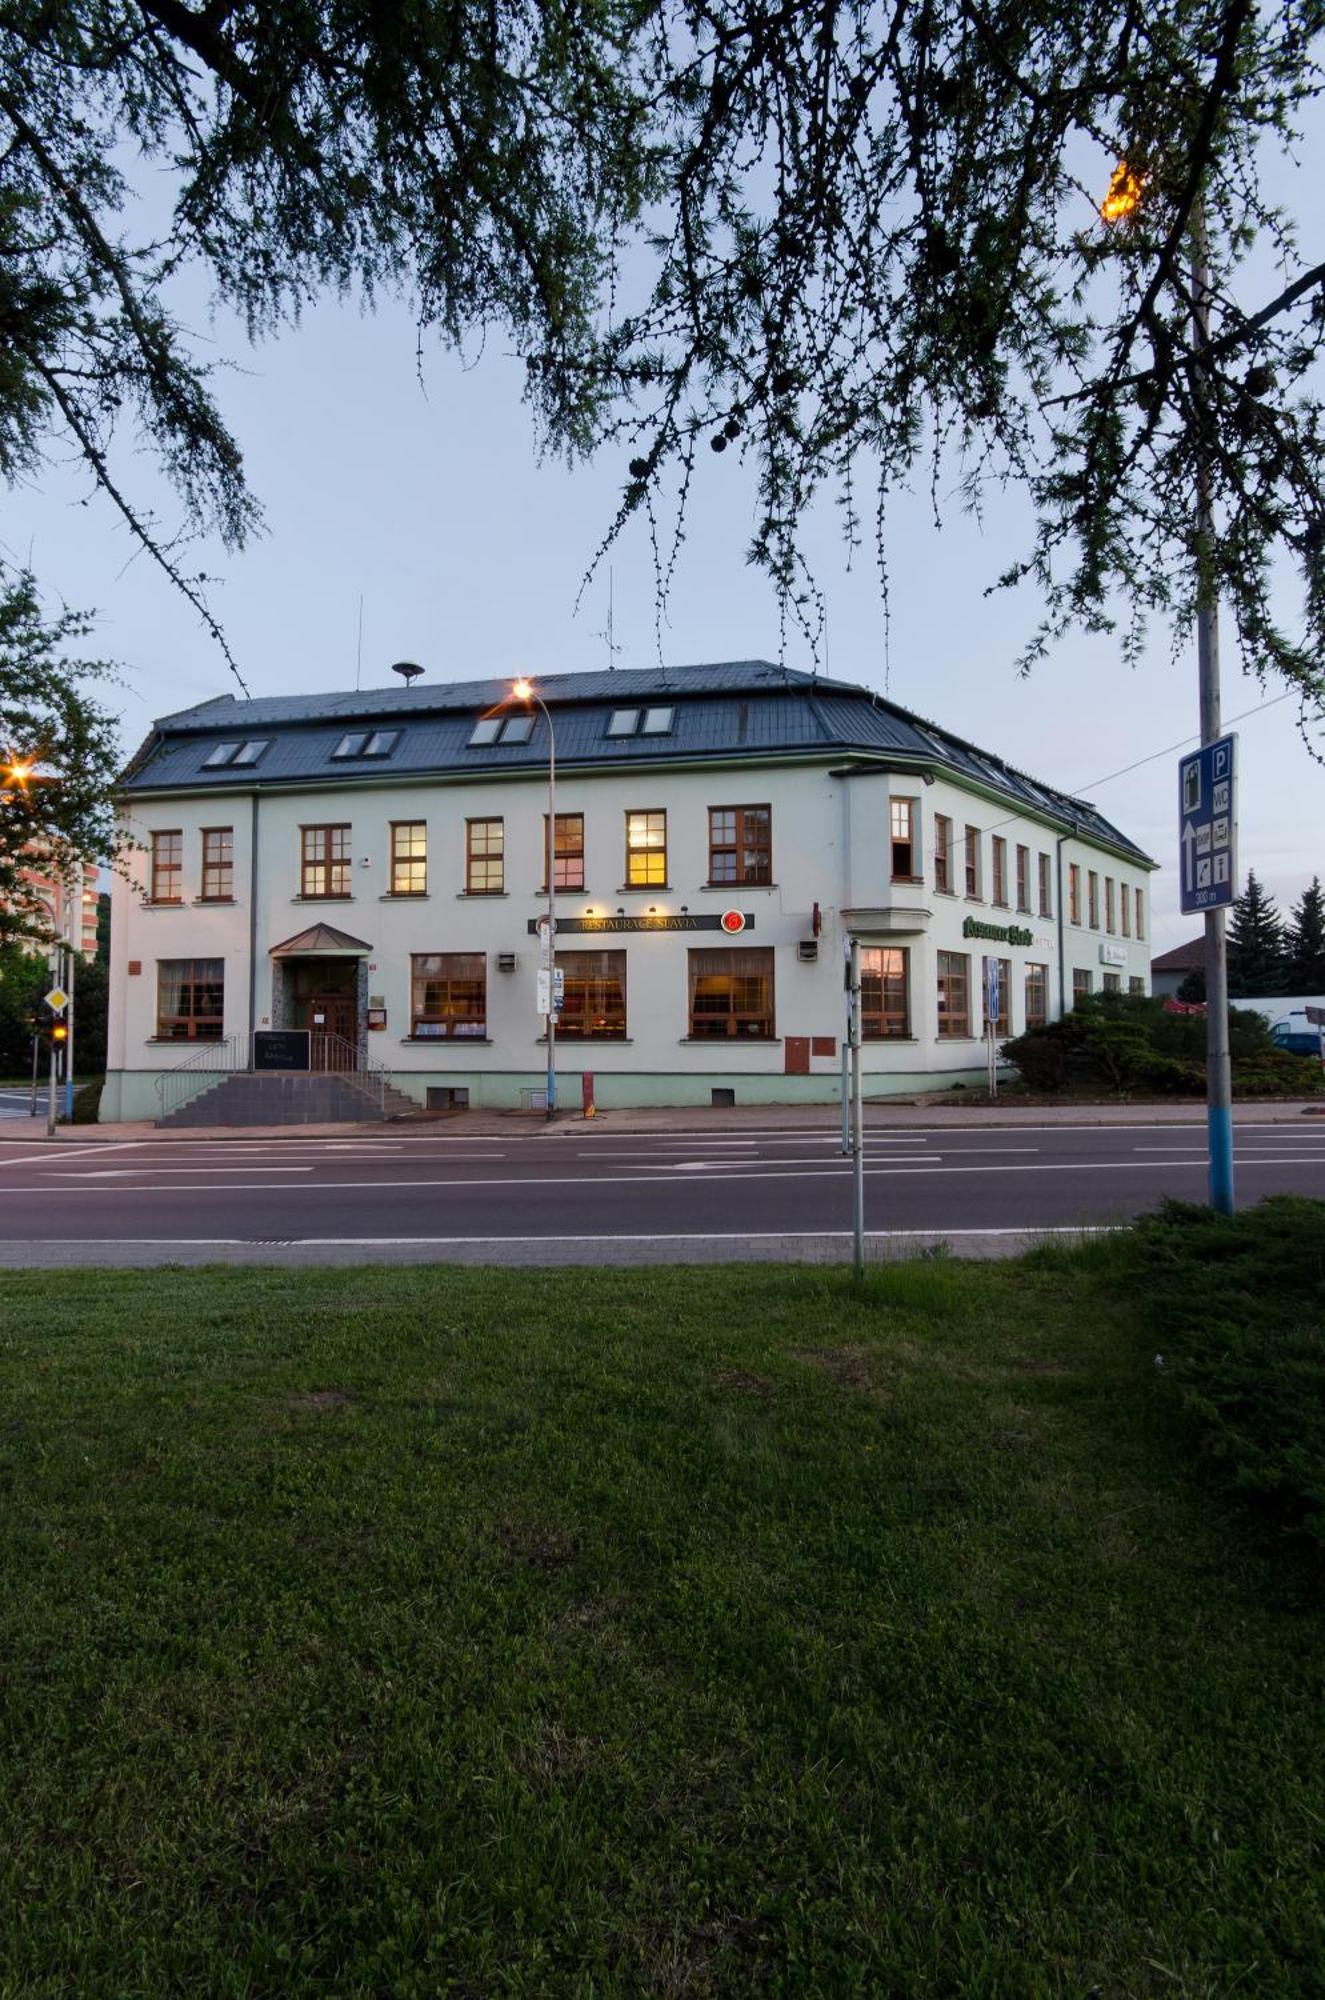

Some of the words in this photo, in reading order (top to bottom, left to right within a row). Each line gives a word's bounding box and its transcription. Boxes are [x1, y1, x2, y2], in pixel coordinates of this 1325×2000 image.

[1216, 750, 1226, 776] P
[1214, 787, 1228, 807] WC
[581, 918, 652, 931] RESTAURACE
[656, 917, 698, 929] SLAVIA
